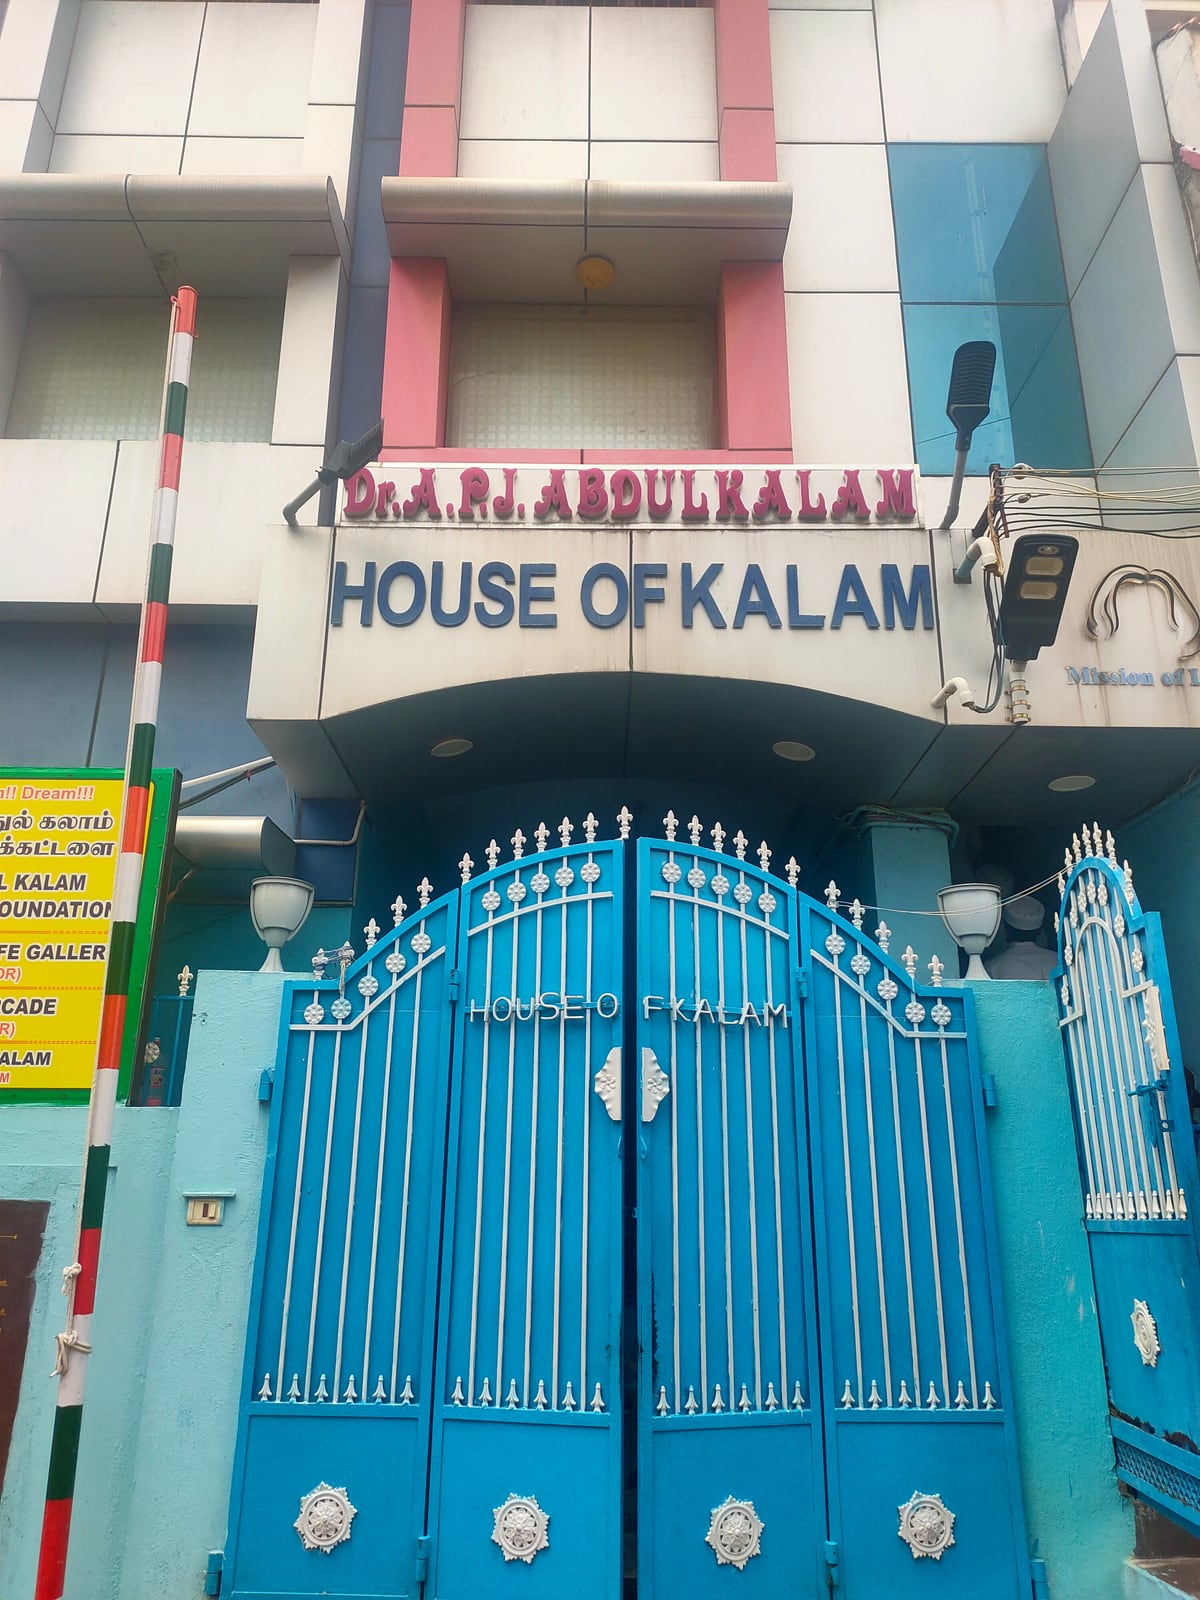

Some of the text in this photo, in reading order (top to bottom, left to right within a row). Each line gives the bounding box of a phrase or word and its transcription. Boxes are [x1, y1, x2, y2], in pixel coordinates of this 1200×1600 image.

[331, 561, 935, 630] HOUSE OF KALAM
[1065, 666, 1155, 687] Mission
[1161, 667, 1185, 687] of
[22, 786, 94, 800] Dream!!!
[39, 810, 114, 830] கலாம்
[14, 874, 87, 891] KALAM
[26, 944, 108, 960] GALLER
[0, 998, 57, 1015] CADE
[470, 992, 584, 1022] HOUSE
